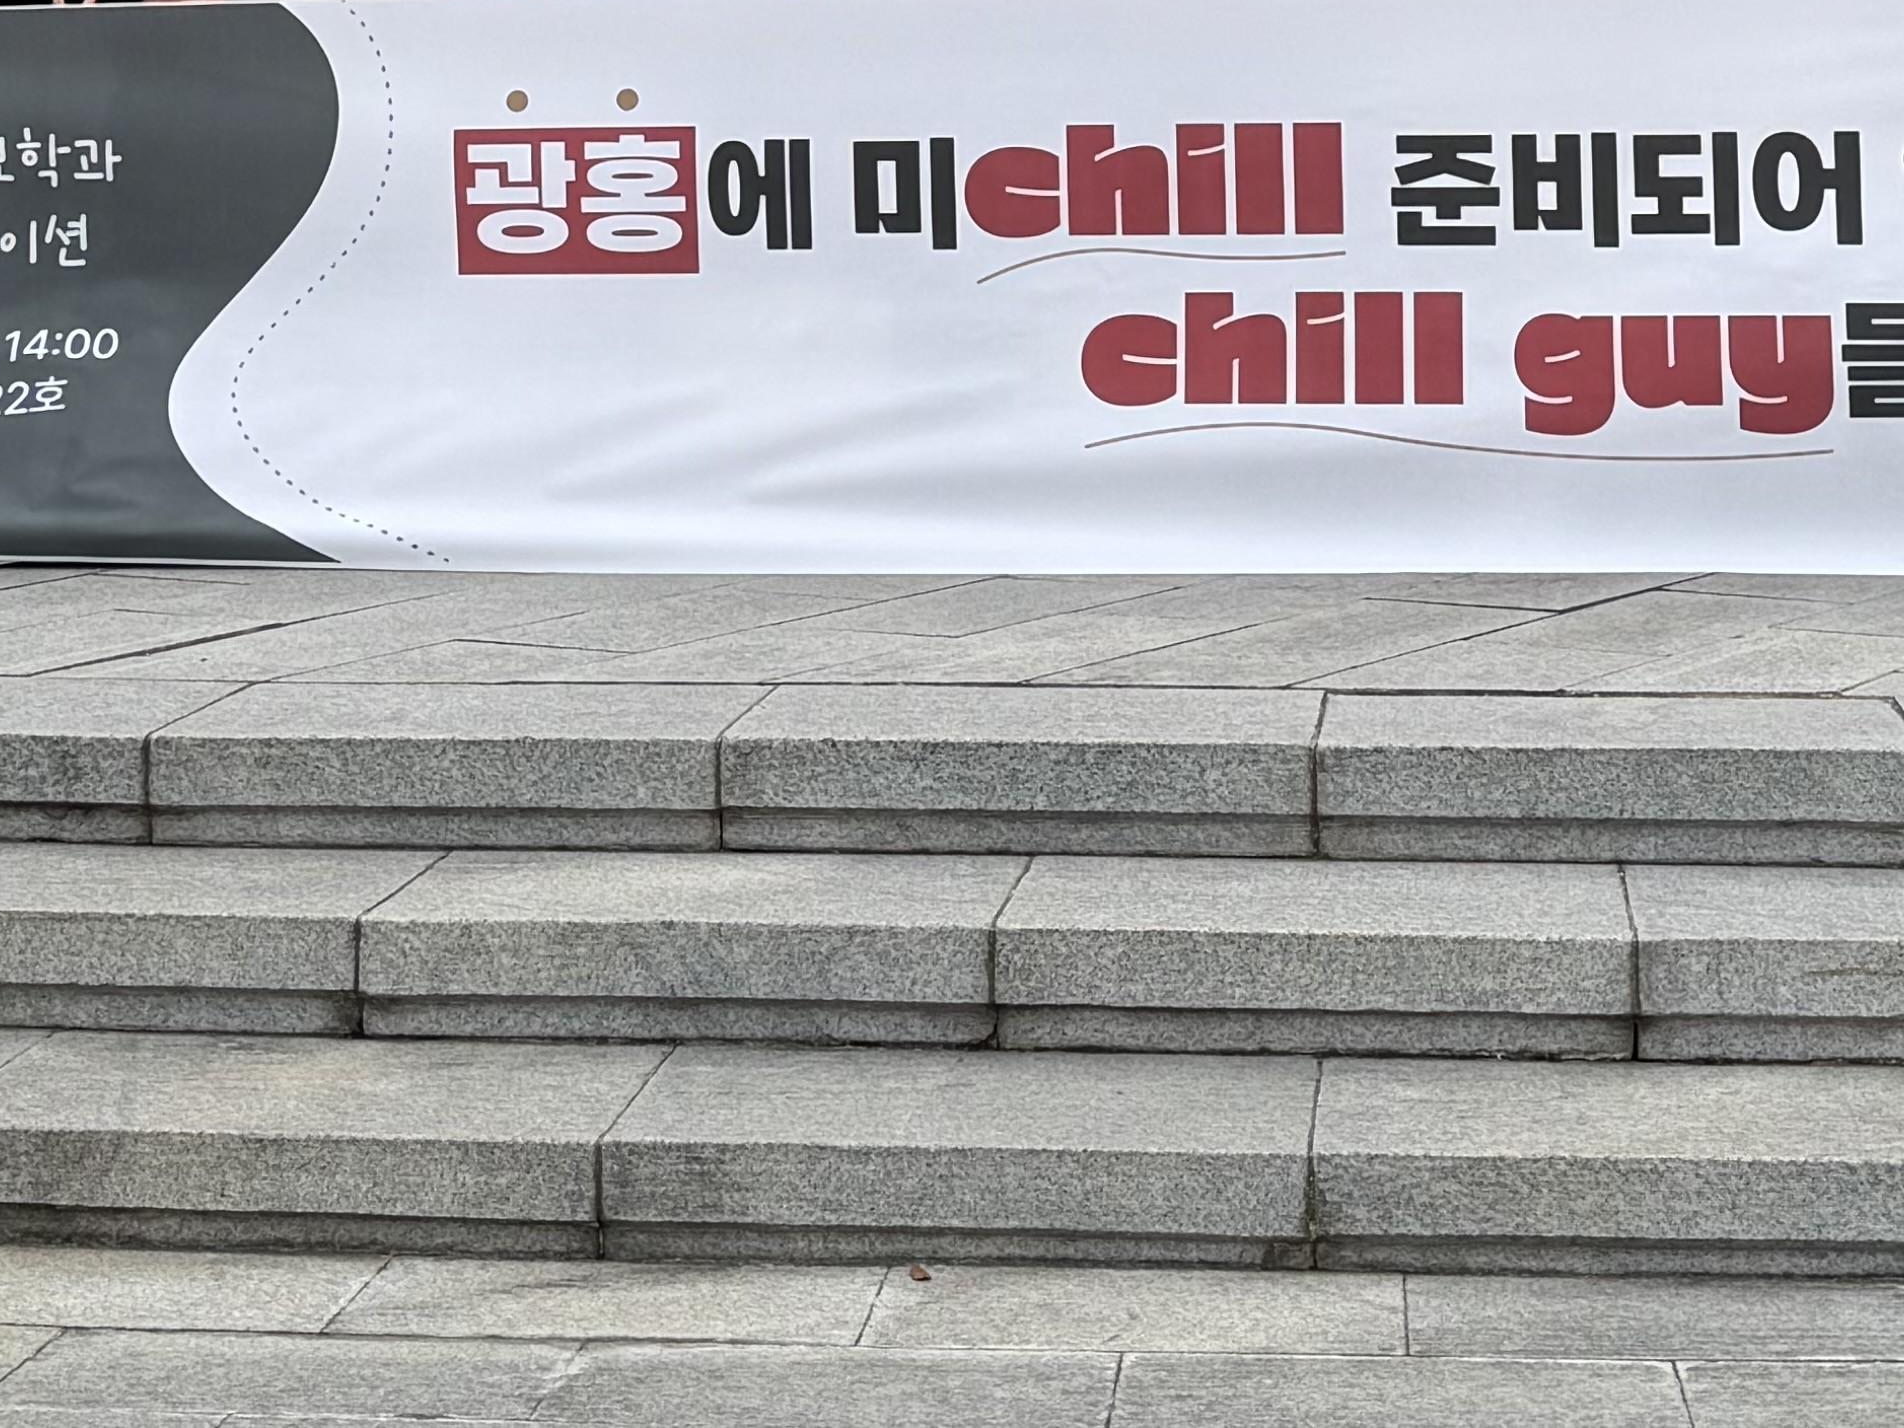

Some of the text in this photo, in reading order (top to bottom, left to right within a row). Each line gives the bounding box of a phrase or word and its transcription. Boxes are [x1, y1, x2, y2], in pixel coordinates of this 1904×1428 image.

[464, 134, 813, 254] 광홍에
[852, 122, 1345, 250] 미chill
[1390, 130, 1864, 249] 준비되어
[5, 328, 120, 363] 14:00
[1080, 291, 1464, 406] chill
